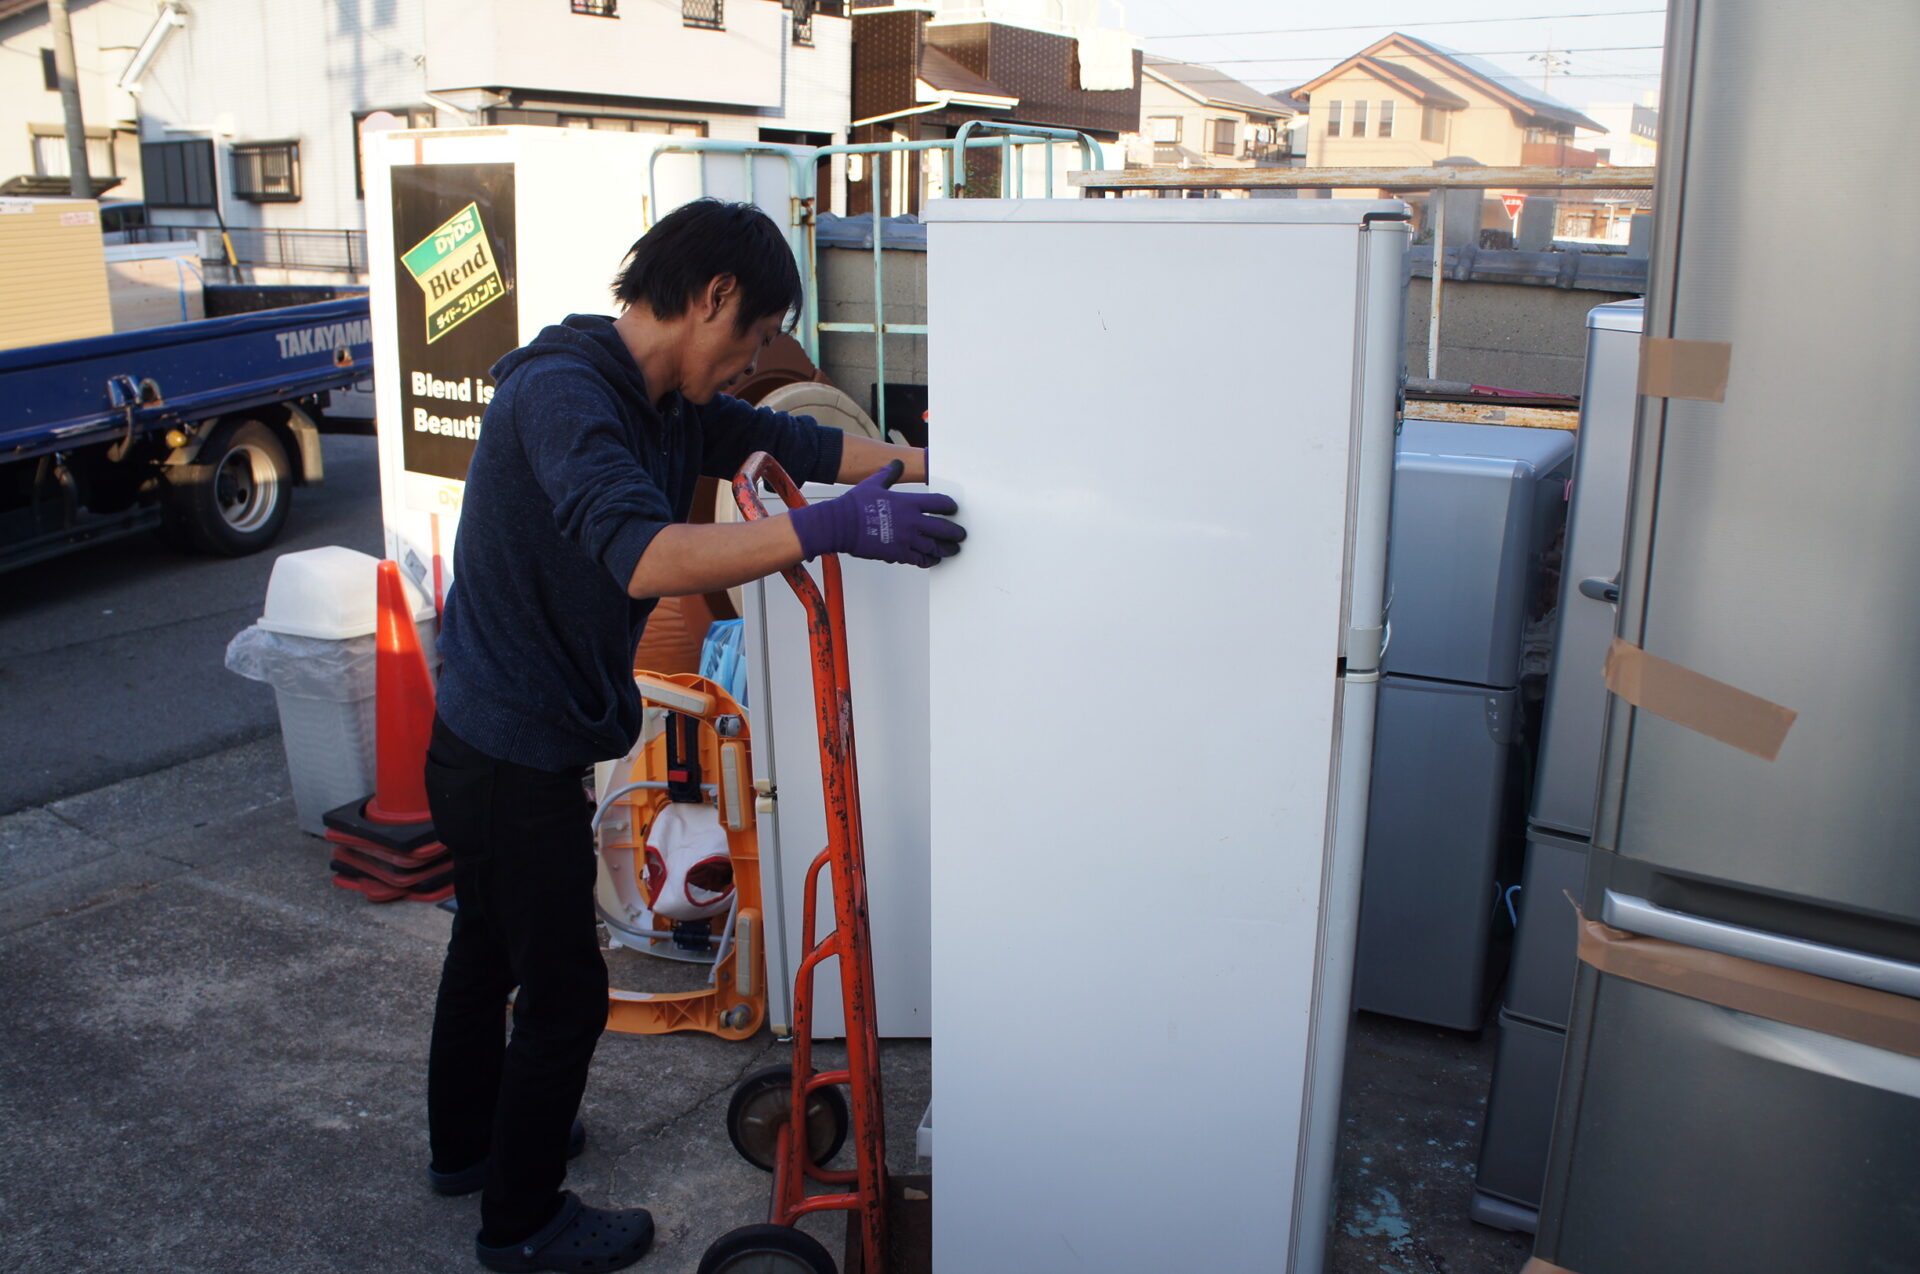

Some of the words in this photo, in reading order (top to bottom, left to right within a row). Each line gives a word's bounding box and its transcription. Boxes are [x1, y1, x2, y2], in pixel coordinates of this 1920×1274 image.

[434, 211, 476, 255] DyDo
[428, 243, 488, 300] Blend
[436, 276, 498, 329] ダイドーブレンド
[275, 319, 373, 359] TAKAYAMA
[411, 370, 472, 402] Blend
[476, 378, 495, 405] is
